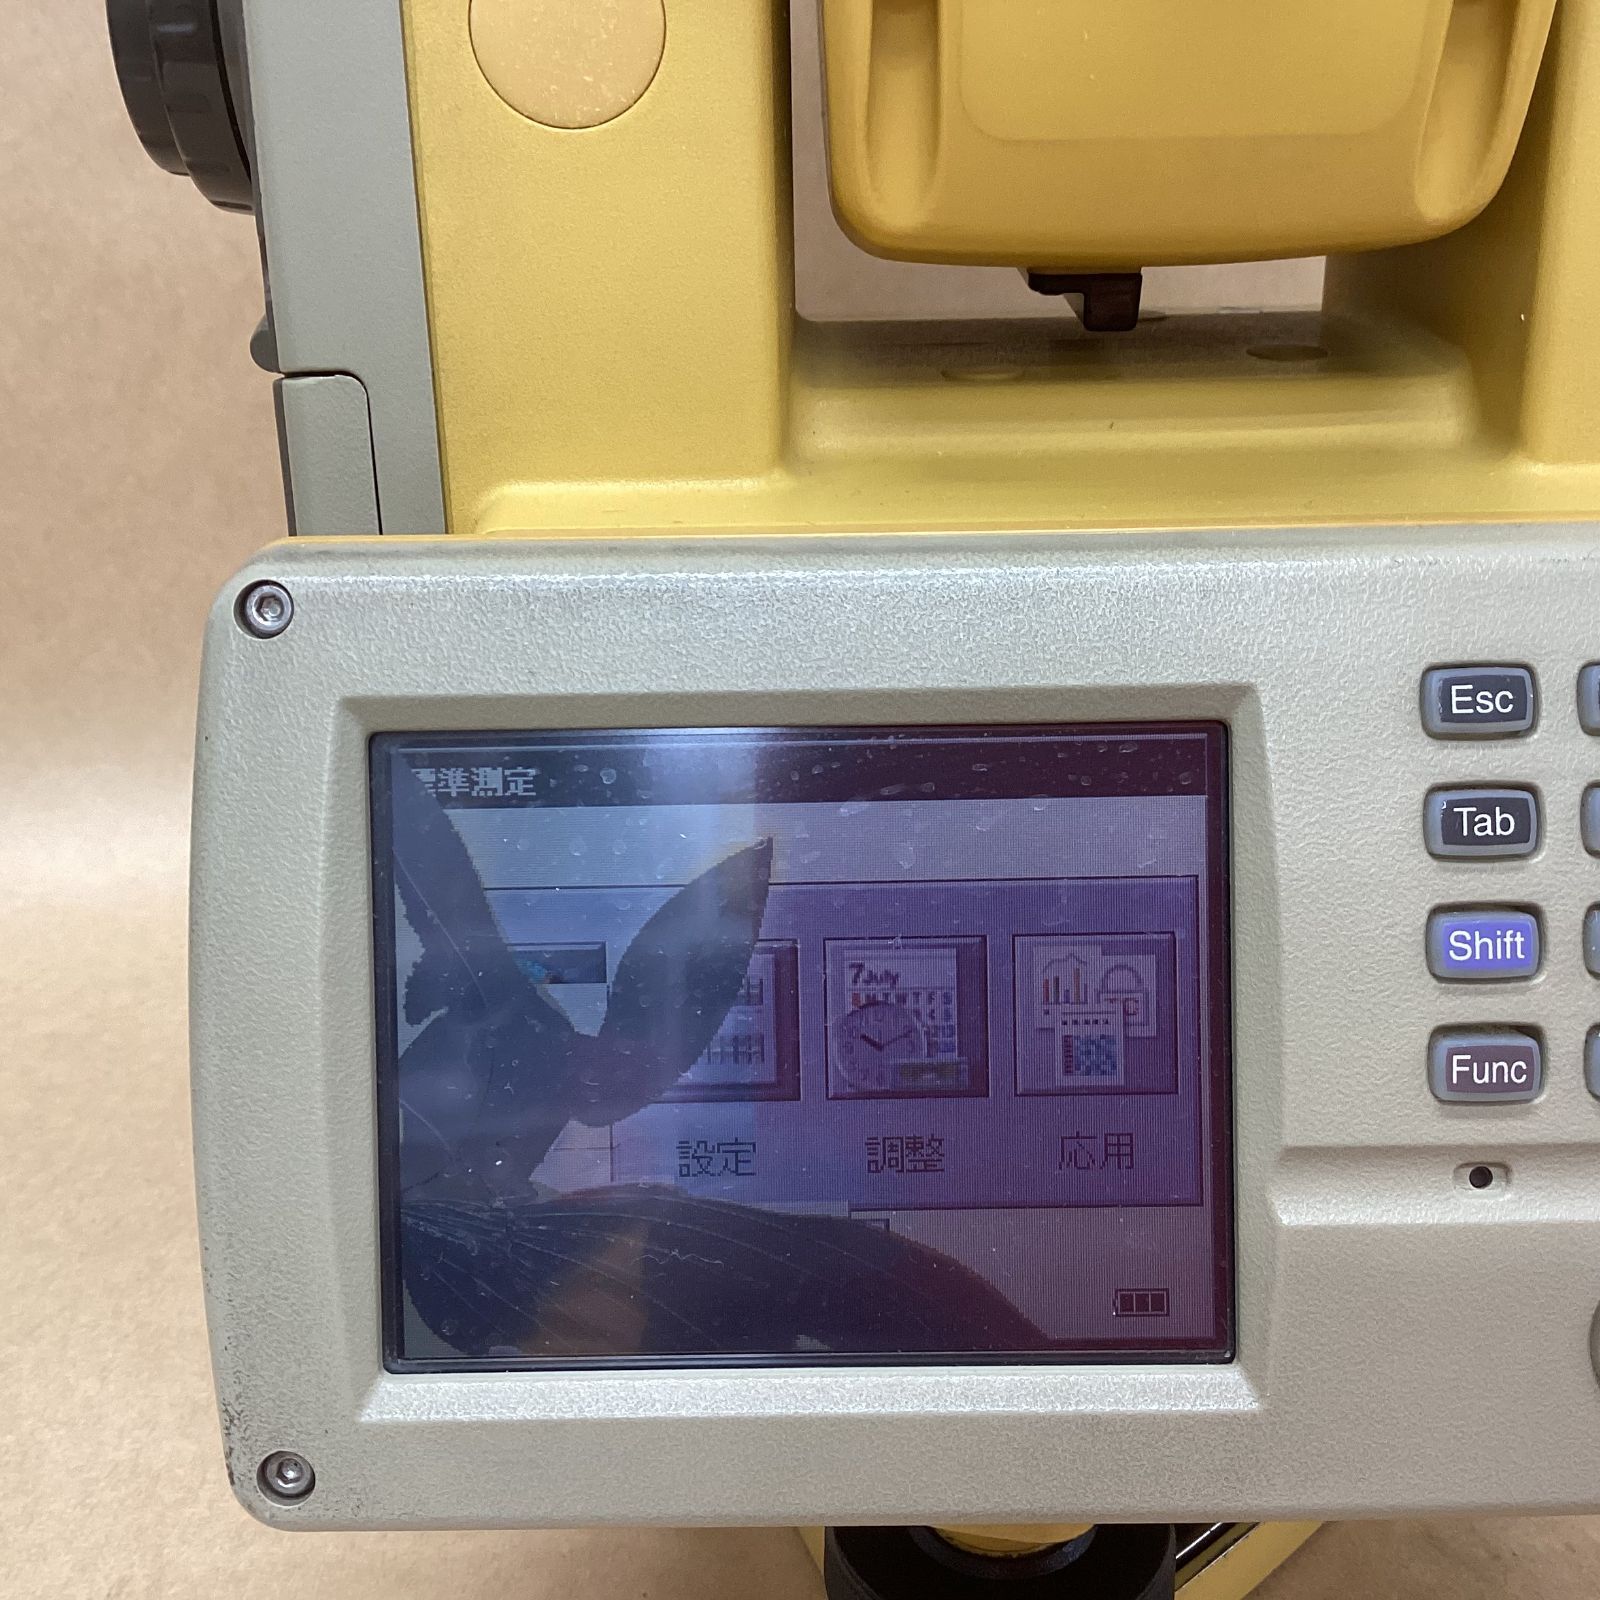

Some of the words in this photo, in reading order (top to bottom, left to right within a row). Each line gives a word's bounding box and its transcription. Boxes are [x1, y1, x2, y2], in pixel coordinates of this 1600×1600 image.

[1450, 684, 1514, 714] Esc
[1453, 807, 1515, 837] Tab
[1448, 930, 1525, 961] Shift
[1451, 1055, 1528, 1085] Func
[677, 1138, 757, 1177] 設定
[866, 1134, 945, 1173] 調整
[1057, 1131, 1135, 1171] 応用
